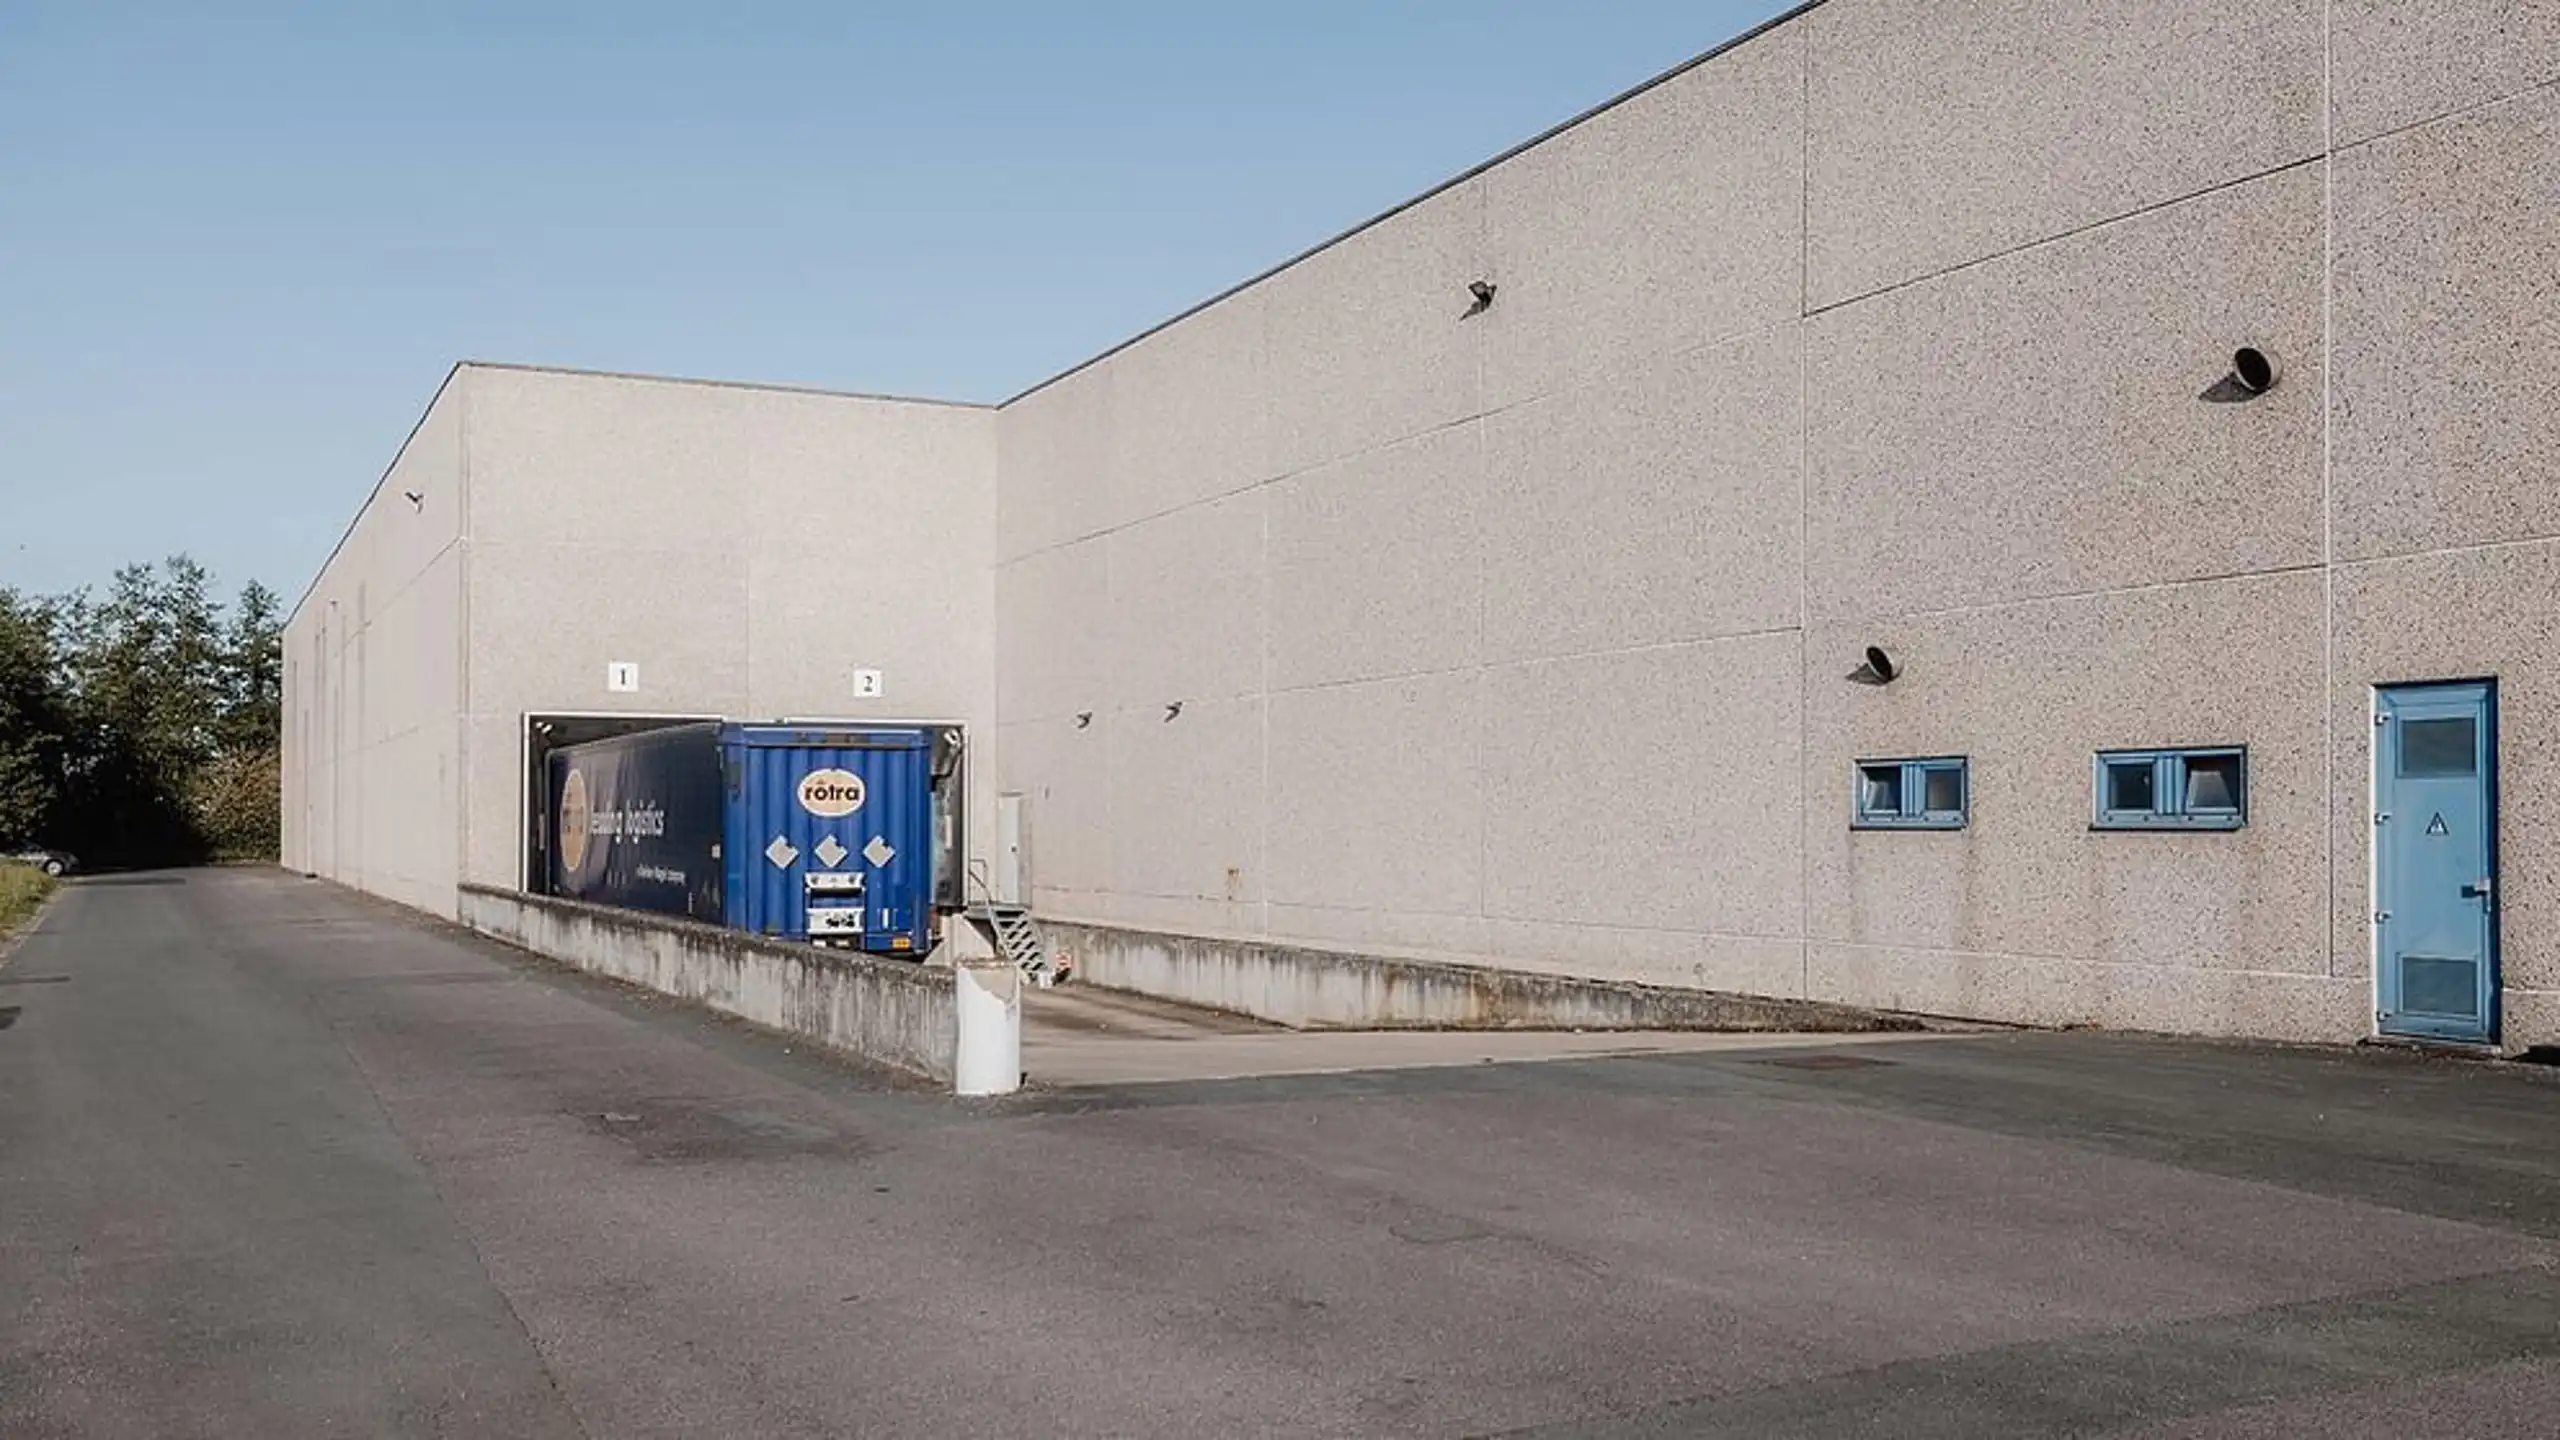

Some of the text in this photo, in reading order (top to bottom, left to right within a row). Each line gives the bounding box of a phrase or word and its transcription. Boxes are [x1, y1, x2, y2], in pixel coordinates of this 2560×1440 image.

[619, 667, 627, 686] 1
[863, 675, 874, 692] 2
[625, 799, 665, 844] logistics
